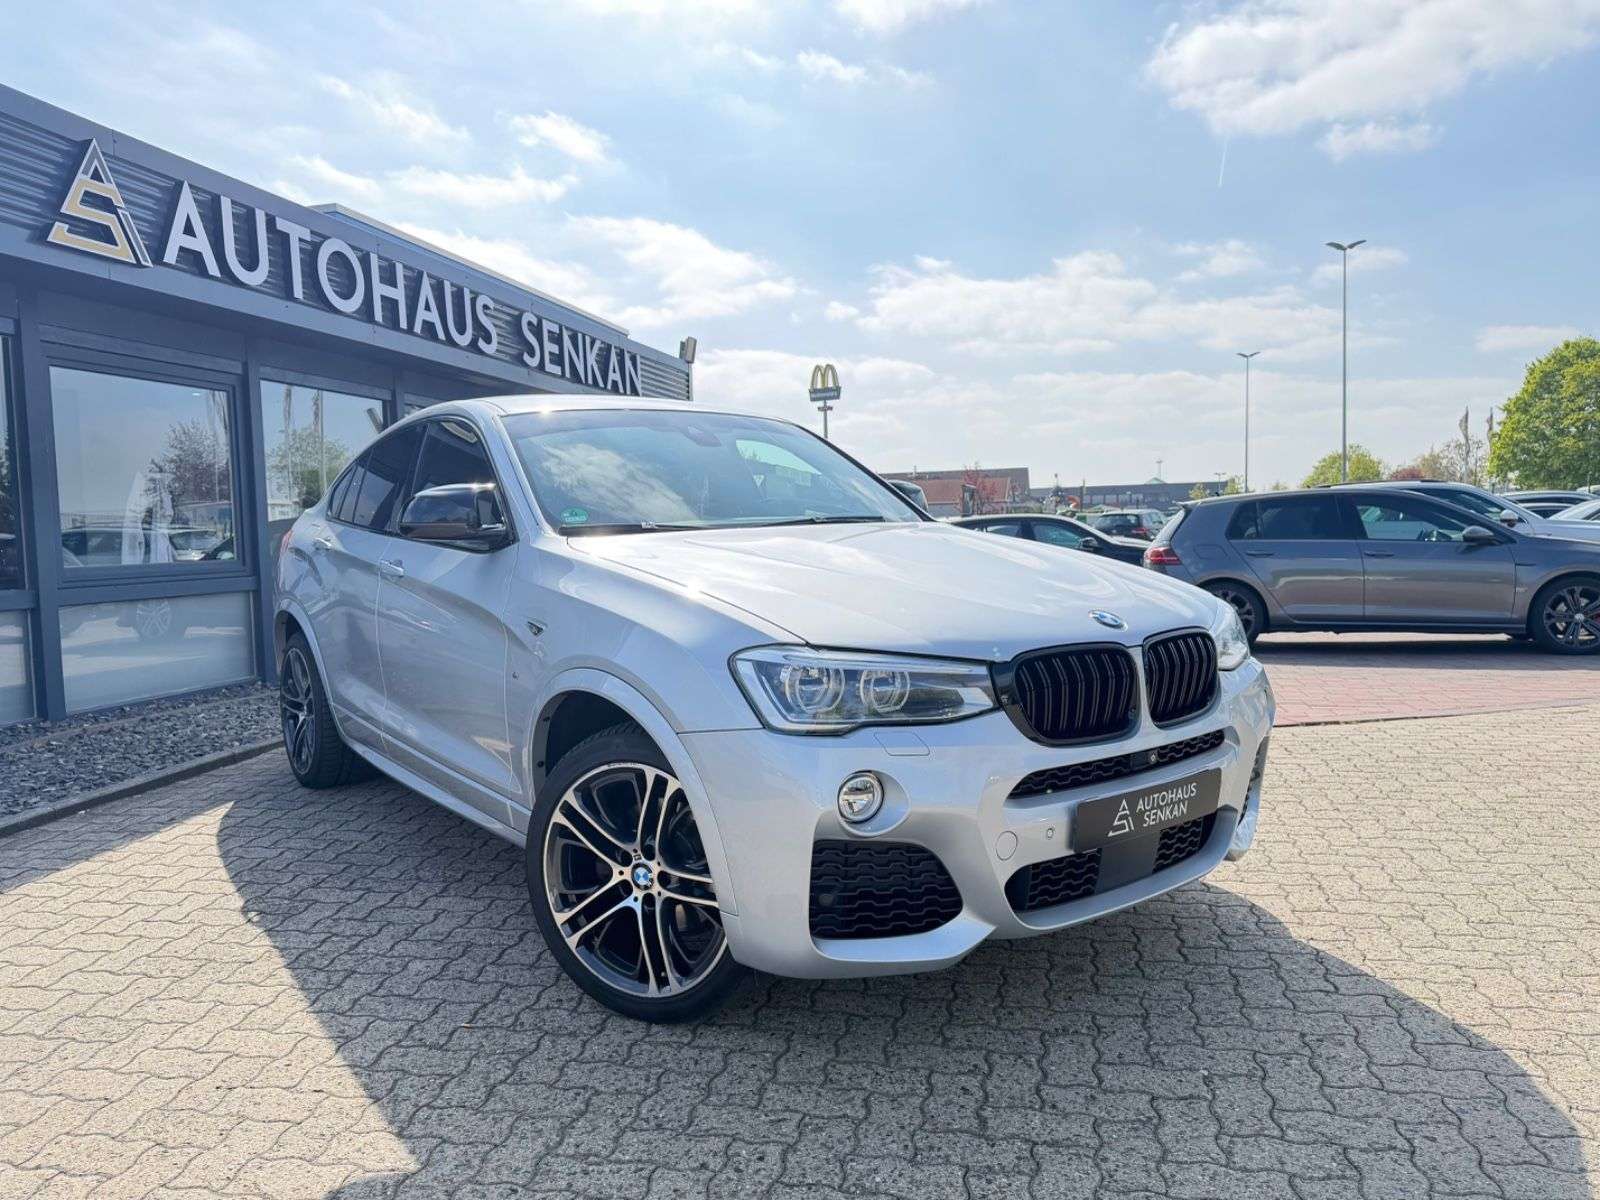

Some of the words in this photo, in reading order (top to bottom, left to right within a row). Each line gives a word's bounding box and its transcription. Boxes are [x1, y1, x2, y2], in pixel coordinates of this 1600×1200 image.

[163, 180, 498, 355] AUTOHAUS
[521, 311, 642, 397] SENKAN
[1136, 782, 1197, 813] AUTOHAUS
[1143, 800, 1188, 827] SENKAN
